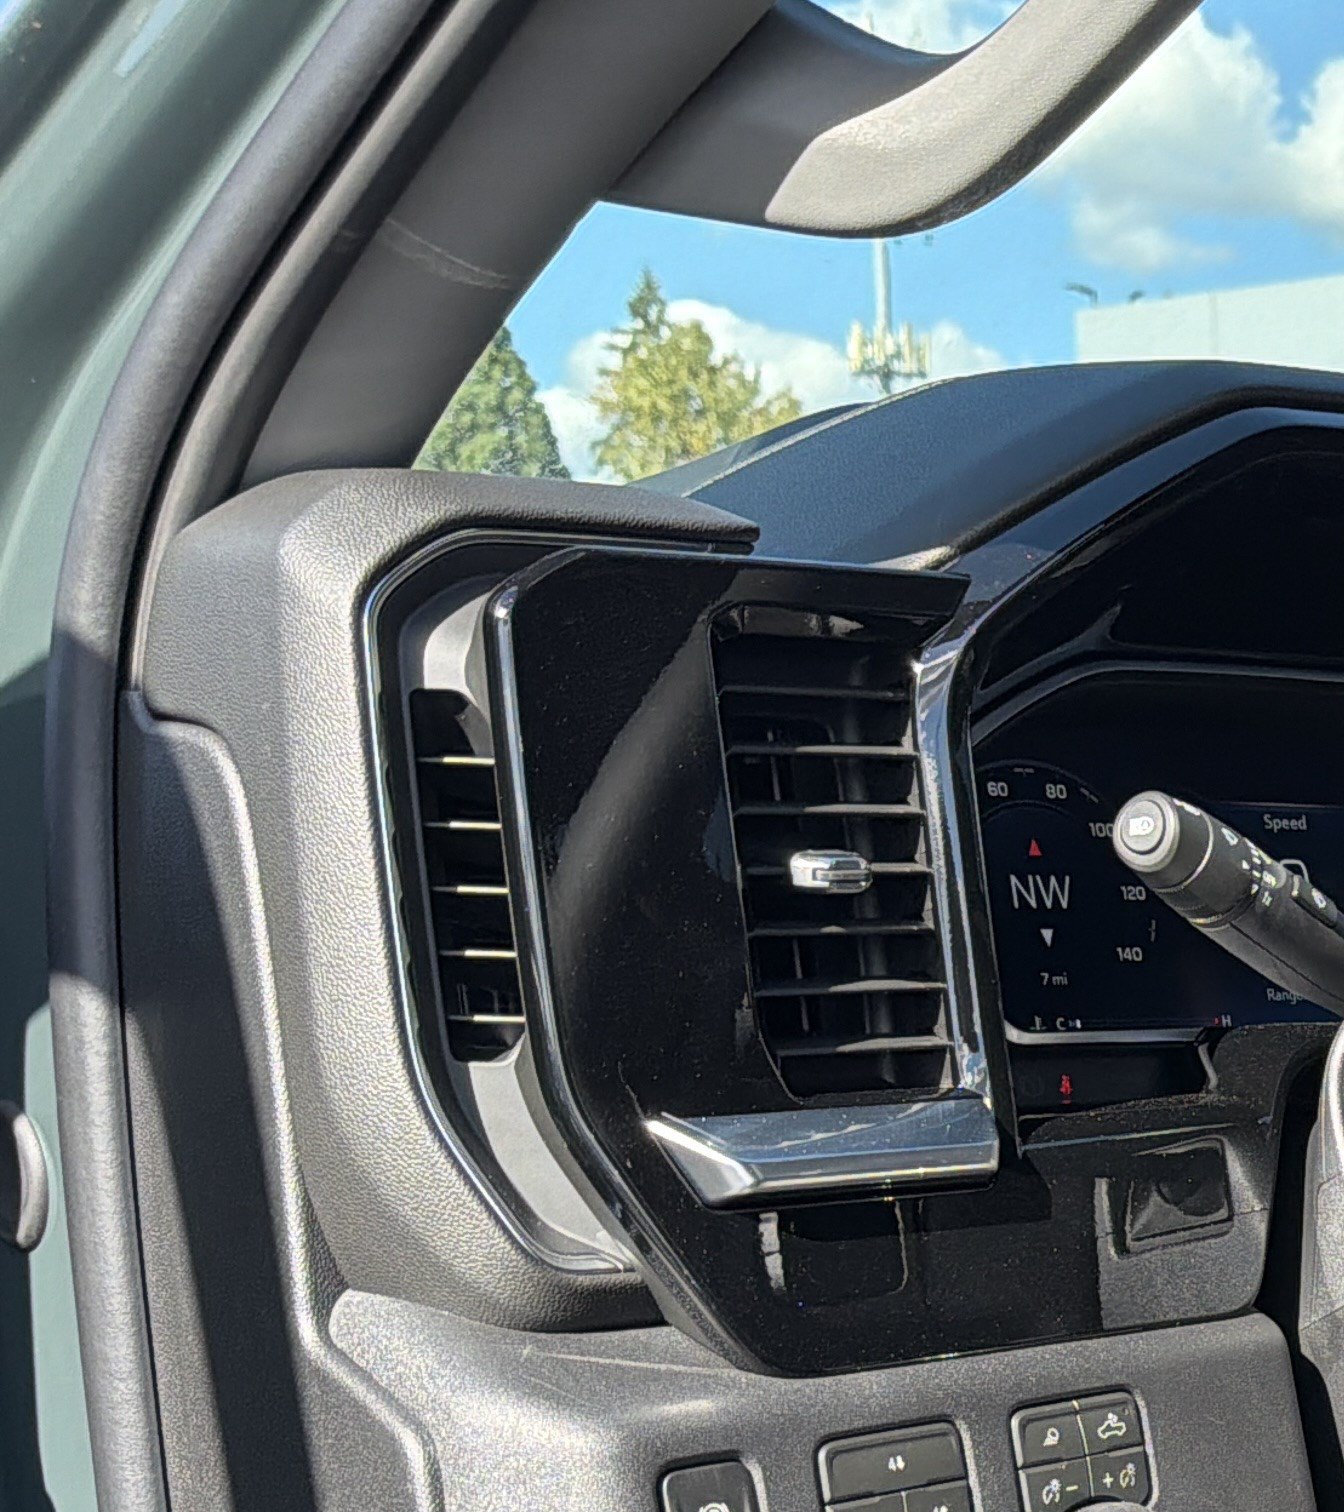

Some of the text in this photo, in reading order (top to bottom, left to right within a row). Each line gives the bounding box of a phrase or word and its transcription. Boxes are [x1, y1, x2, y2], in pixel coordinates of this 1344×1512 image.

[987, 781, 1008, 797] 60
[1045, 783, 1067, 799] 80
[1263, 813, 1307, 833] Speed
[1009, 873, 1070, 909] NW
[1119, 885, 1146, 901] 120
[1115, 946, 1143, 962] 140
[1040, 971, 1068, 986] 7 mi
[1056, 1015, 1066, 1031] C
[1221, 1015, 1232, 1027] H
